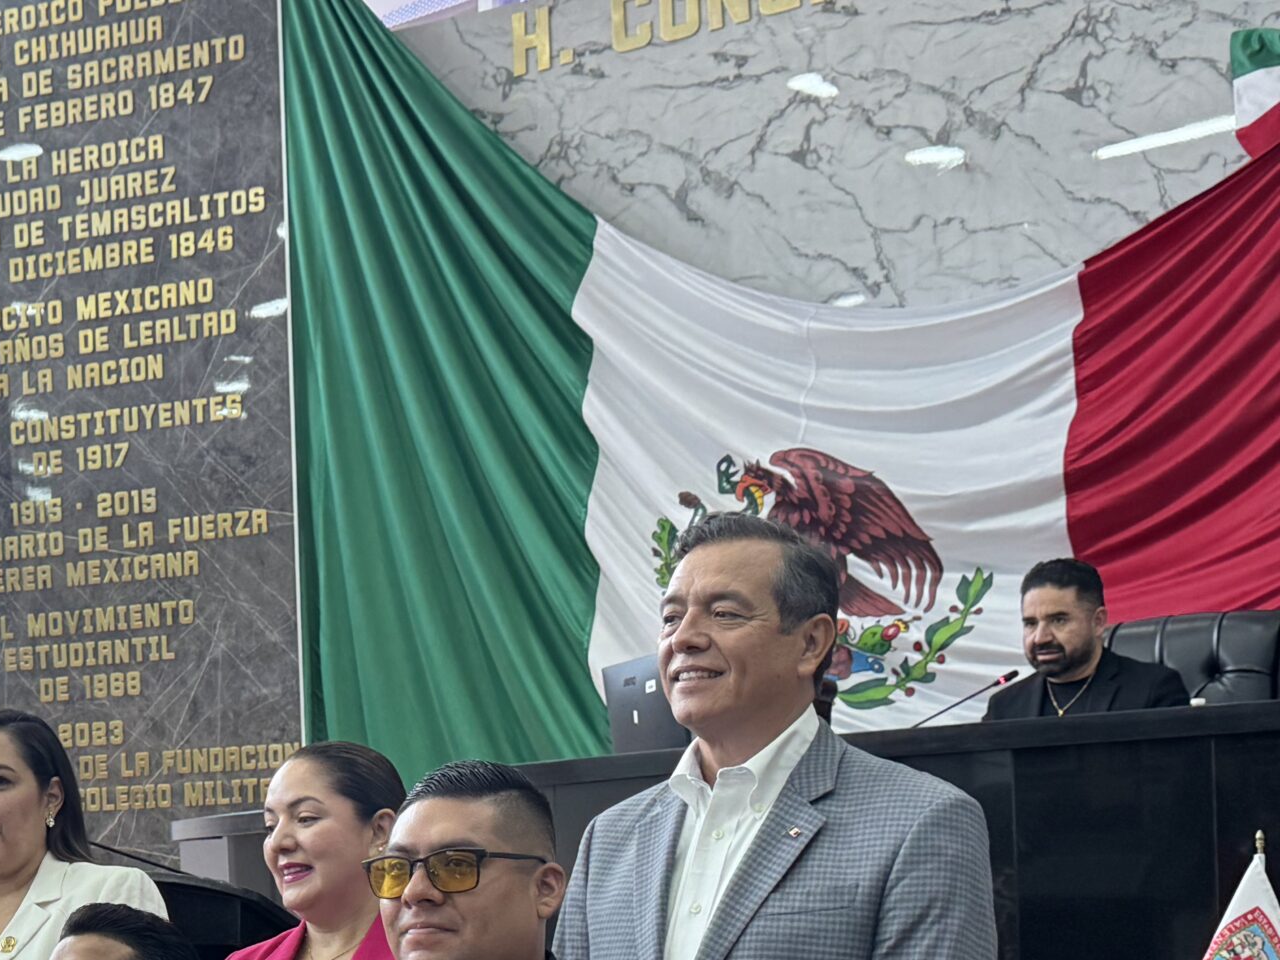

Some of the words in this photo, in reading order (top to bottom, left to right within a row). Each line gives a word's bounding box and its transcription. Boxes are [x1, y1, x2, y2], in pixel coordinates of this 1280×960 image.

[14, 15, 163, 66] CHIHUAHUA
[512, 6, 574, 77] H.
[22, 69, 53, 98] DE
[67, 34, 245, 90] SACRAMENTO
[19, 89, 133, 133] FEBRERO
[148, 75, 214, 110] 1847
[6, 156, 38, 183] LA
[52, 134, 164, 176] HEROICA
[76, 166, 177, 206] JUAREZ
[14, 220, 44, 247] DE
[58, 187, 266, 242] TEMASCALITOS
[9, 237, 155, 283] DICIEMBRE
[168, 226, 234, 259] 1846
[76, 277, 213, 321] MEXICANO
[0, 334, 64, 364] AÑOS
[79, 328, 109, 354] DE
[124, 309, 237, 348] LEALTAD
[22, 369, 53, 395] LA
[67, 354, 164, 390] NACION
[10, 394, 243, 446] CONSTITUYENTES
[32, 450, 63, 477] DE
[76, 442, 130, 471] 1917
[97, 487, 157, 519] 2015
[78, 526, 109, 553] DE
[122, 522, 153, 548] LA
[169, 508, 268, 542] FUERZA
[66, 550, 199, 588] MEXICANA
[27, 600, 195, 638] MOVIMIENTO
[4, 634, 176, 672] ESTUDIANTIL
[39, 676, 69, 702] DE
[82, 671, 141, 699] 1968
[58, 720, 124, 748] 2023
[79, 753, 108, 781] DE
[121, 751, 150, 777] LA
[162, 742, 300, 776] FUNDACION
